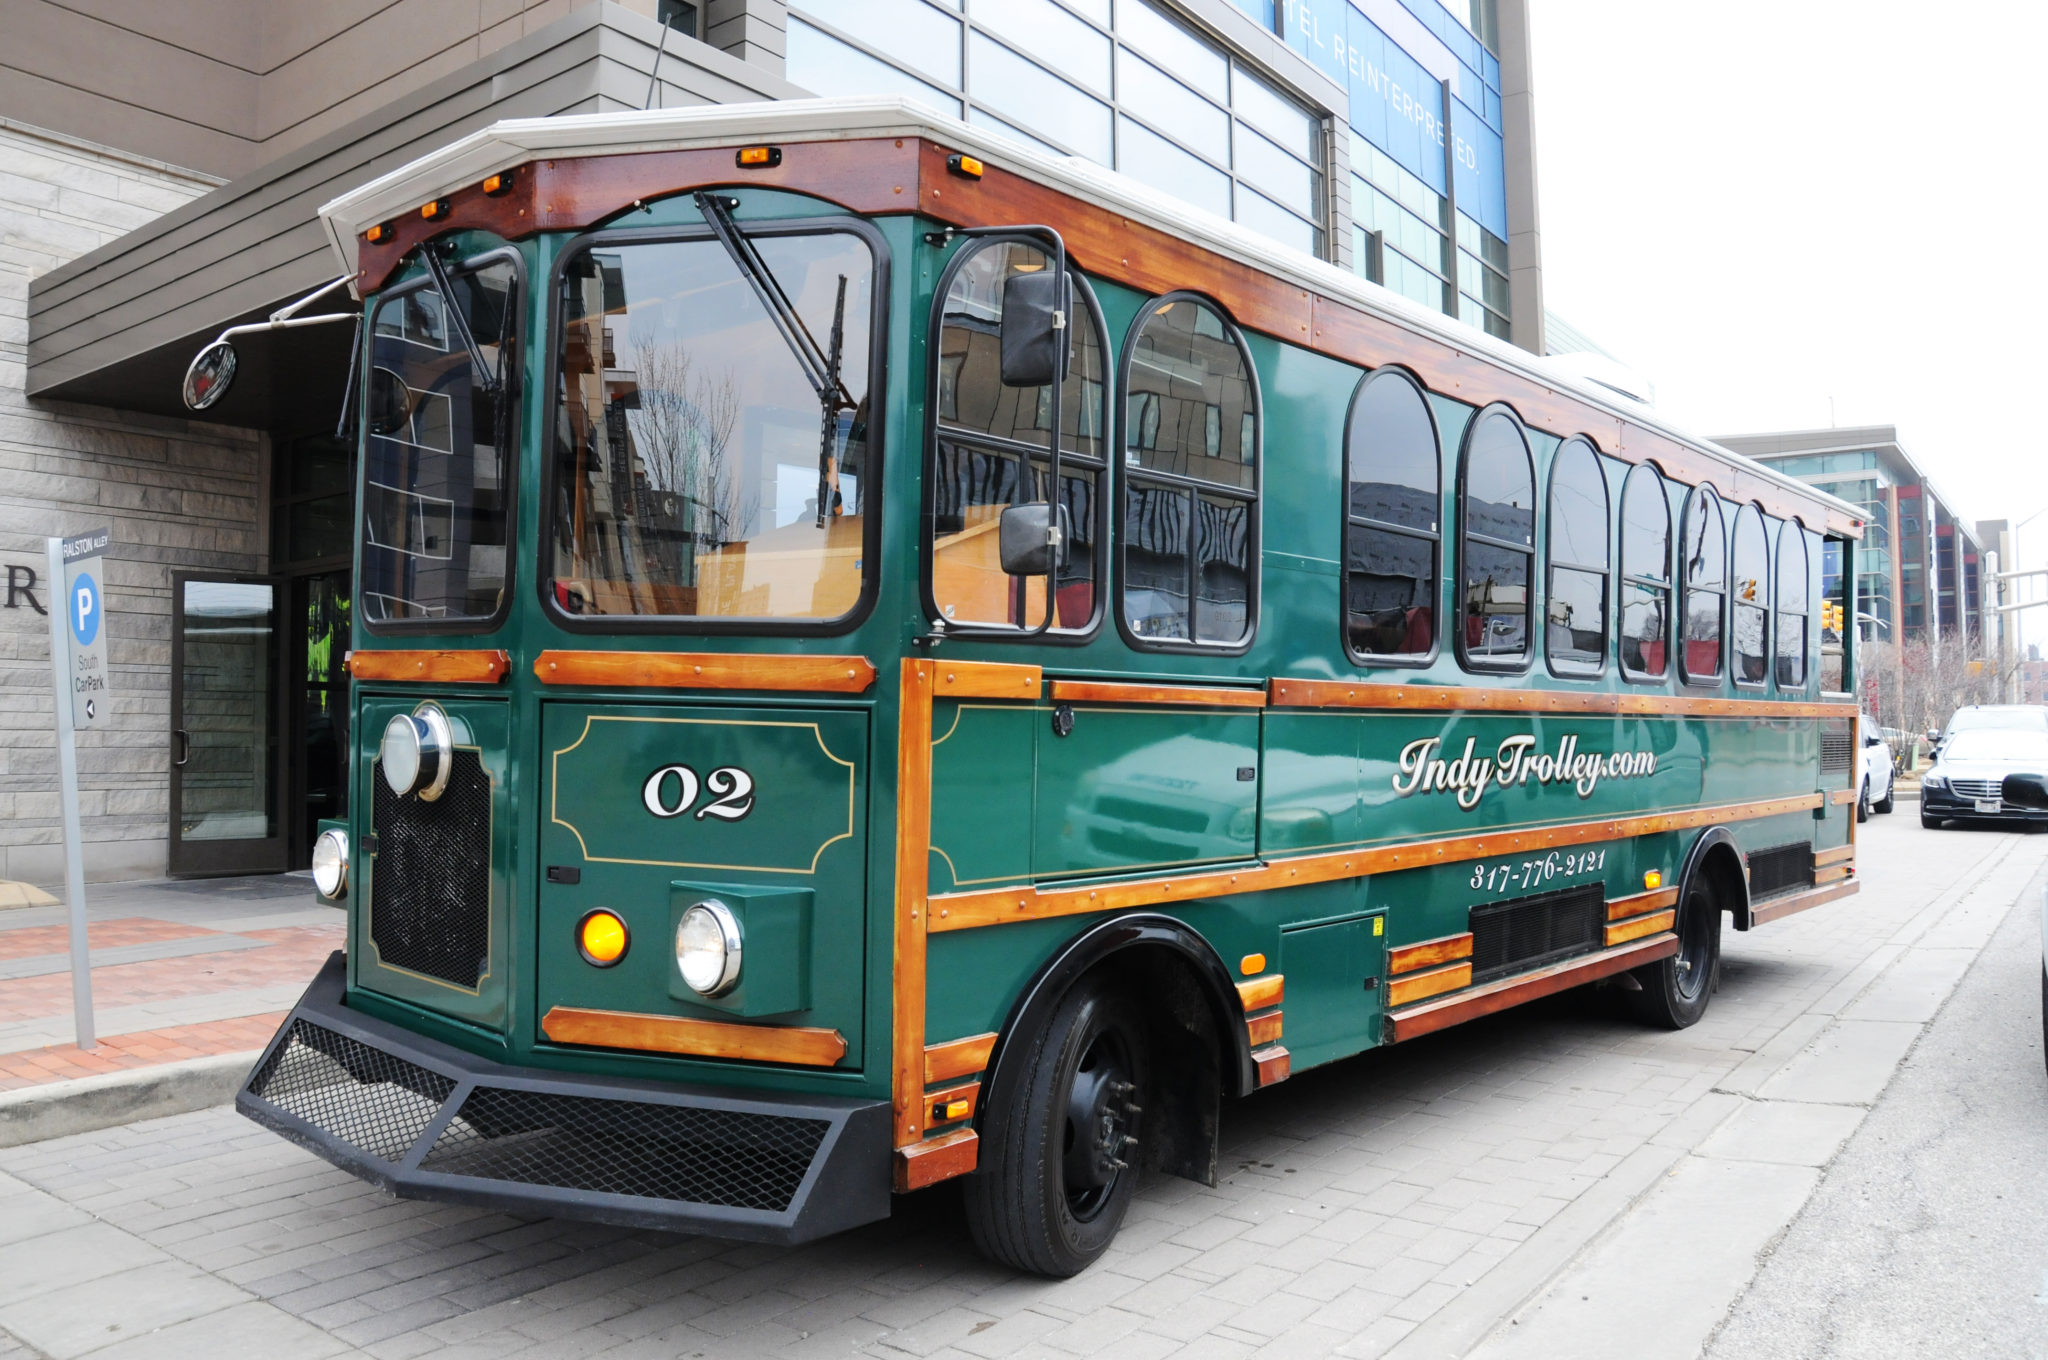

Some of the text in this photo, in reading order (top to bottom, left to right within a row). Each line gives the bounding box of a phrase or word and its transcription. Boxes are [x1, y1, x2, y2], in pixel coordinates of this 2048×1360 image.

[1273, 0, 1480, 176] TEL REINTERPREED.
[63, 536, 109, 558] RALSTON ALLEY
[4, 564, 48, 616] R
[77, 588, 92, 632] P
[75, 675, 105, 693] CarPark
[78, 653, 99, 671] South
[641, 763, 757, 823] 02
[1470, 849, 1607, 894] 317-776-2121
